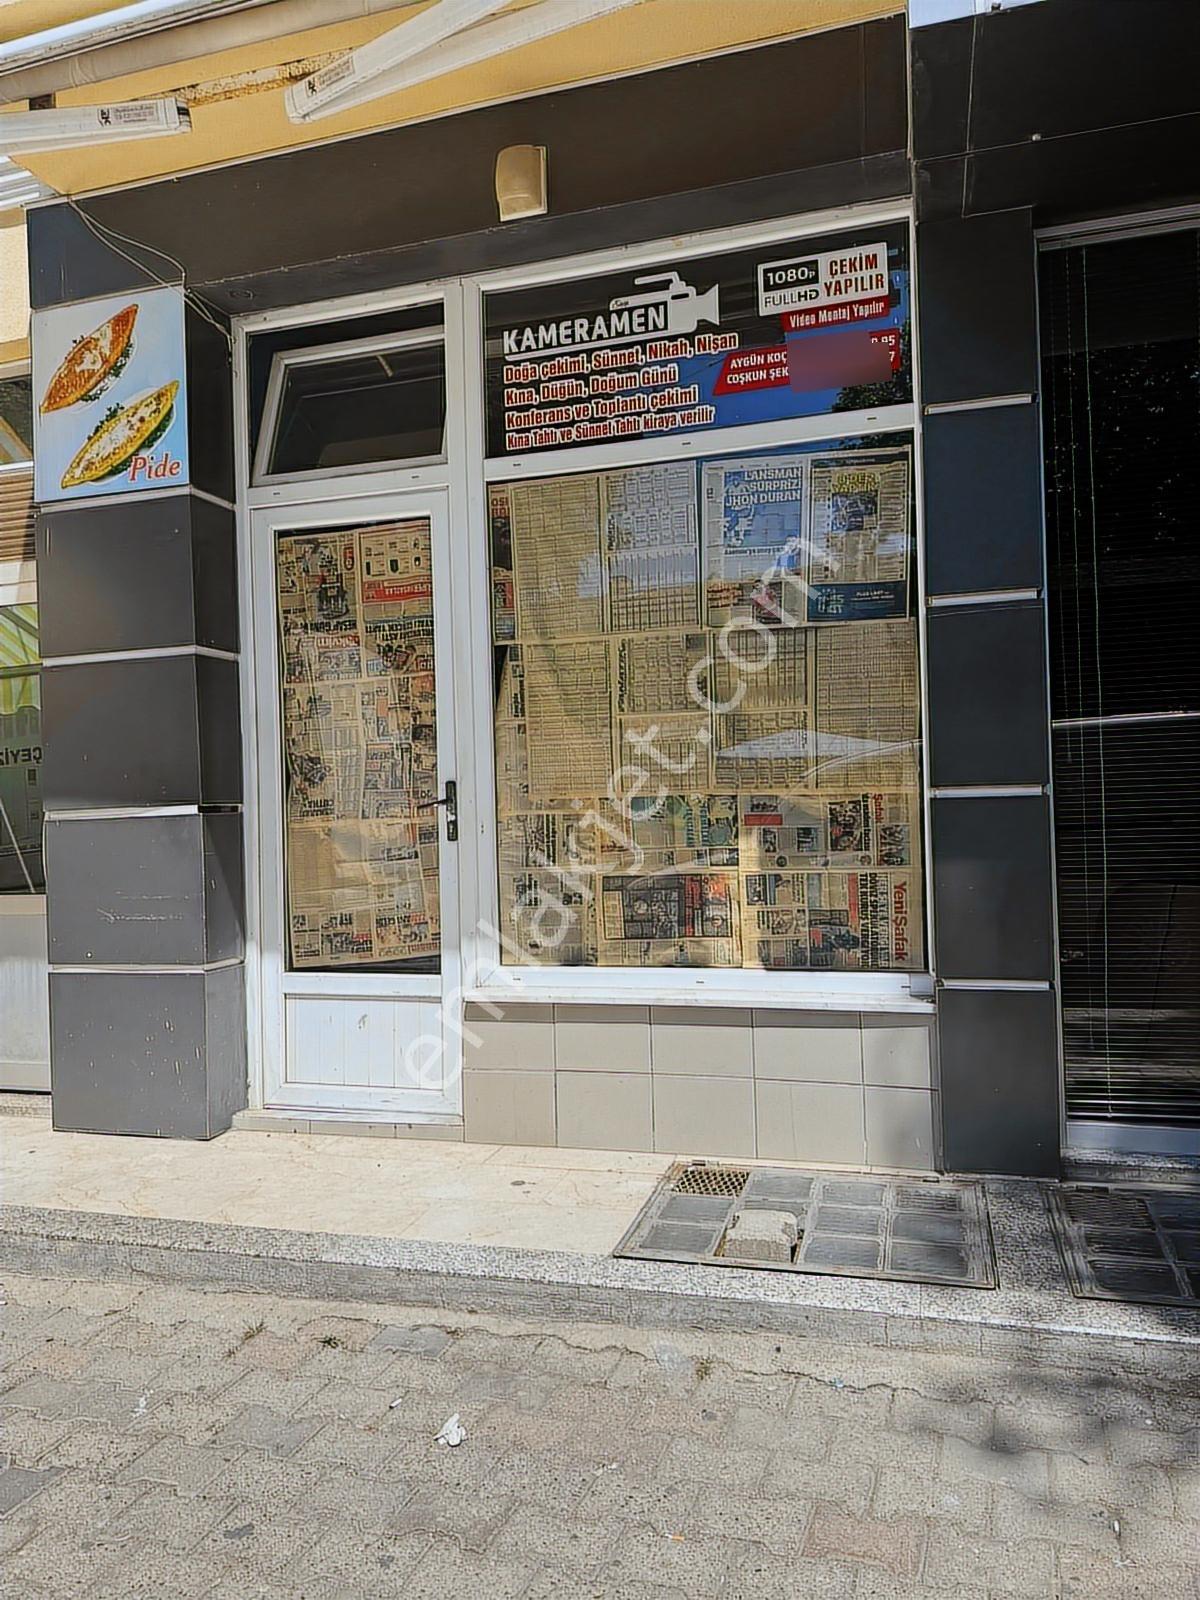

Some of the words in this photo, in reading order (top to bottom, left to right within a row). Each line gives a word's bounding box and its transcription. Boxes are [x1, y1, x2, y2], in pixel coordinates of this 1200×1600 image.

[828, 252, 878, 278] ÇEKİM
[824, 273, 885, 297] YAPILIR
[789, 313, 816, 328] Video
[818, 306, 851, 323] Montaj
[852, 300, 885, 318] Yapılır
[503, 305, 665, 354] KAMERAMEN
[504, 363, 537, 384] Doğa
[541, 355, 590, 377] çekimi,
[593, 345, 645, 370] Sünnet,
[648, 337, 693, 360] Nikah,
[695, 331, 739, 355] Nişan
[730, 352, 765, 370] AYGÜN
[505, 388, 539, 407] Kına,
[541, 379, 589, 402] Düğün,
[590, 372, 640, 396] Doğum
[641, 363, 679, 387] Günü
[727, 369, 767, 385] COŞKUN
[769, 366, 790, 380] ŞEK
[505, 406, 571, 430] Konferans
[574, 403, 590, 421] ve
[593, 395, 648, 417] Toplantı
[650, 385, 698, 408] çekimi
[506, 431, 530, 450] Kına
[559, 427, 573, 442] ve
[575, 422, 612, 442] Sünnet
[642, 412, 677, 432] kiraya
[679, 405, 715, 425] verilir
[129, 452, 181, 481] Pide
